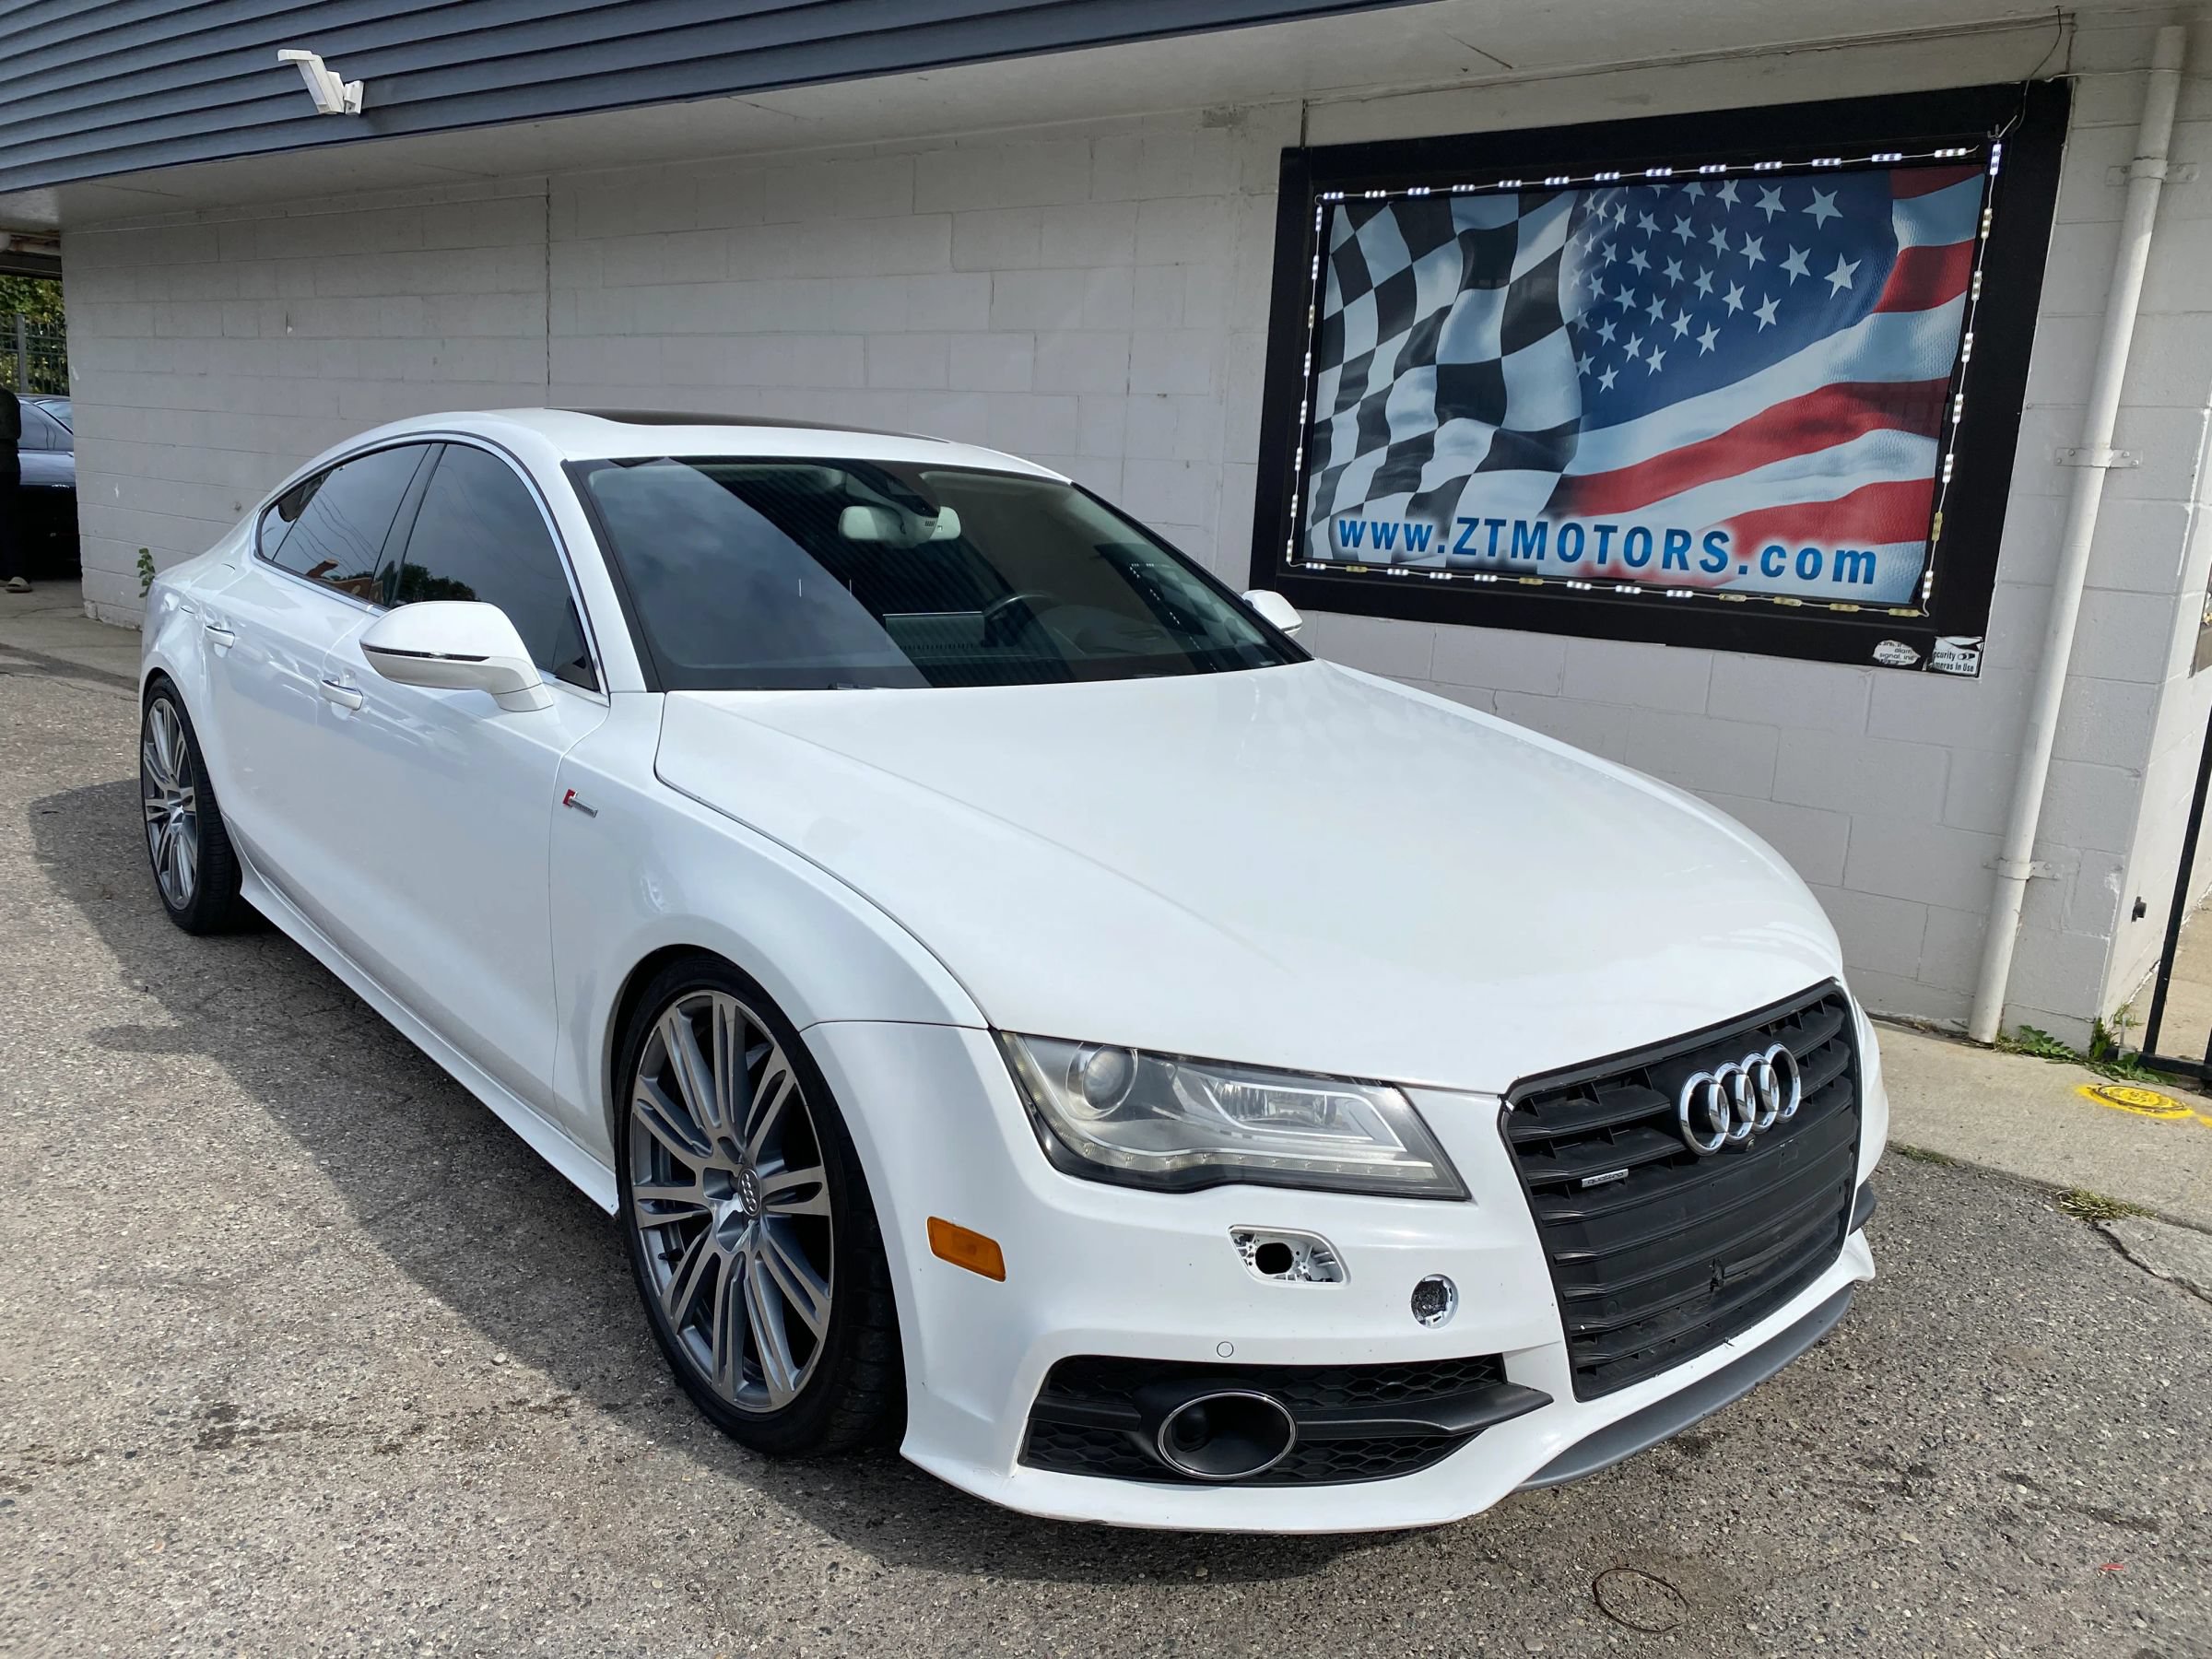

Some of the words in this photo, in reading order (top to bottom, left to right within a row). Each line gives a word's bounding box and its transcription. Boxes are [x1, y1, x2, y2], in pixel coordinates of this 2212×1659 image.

[1337, 515, 1877, 585] www.ZTMOTORS.com
[1933, 650, 1956, 662] ecurity
[1935, 662, 1954, 670] meras
[1962, 663, 1974, 672] Use
